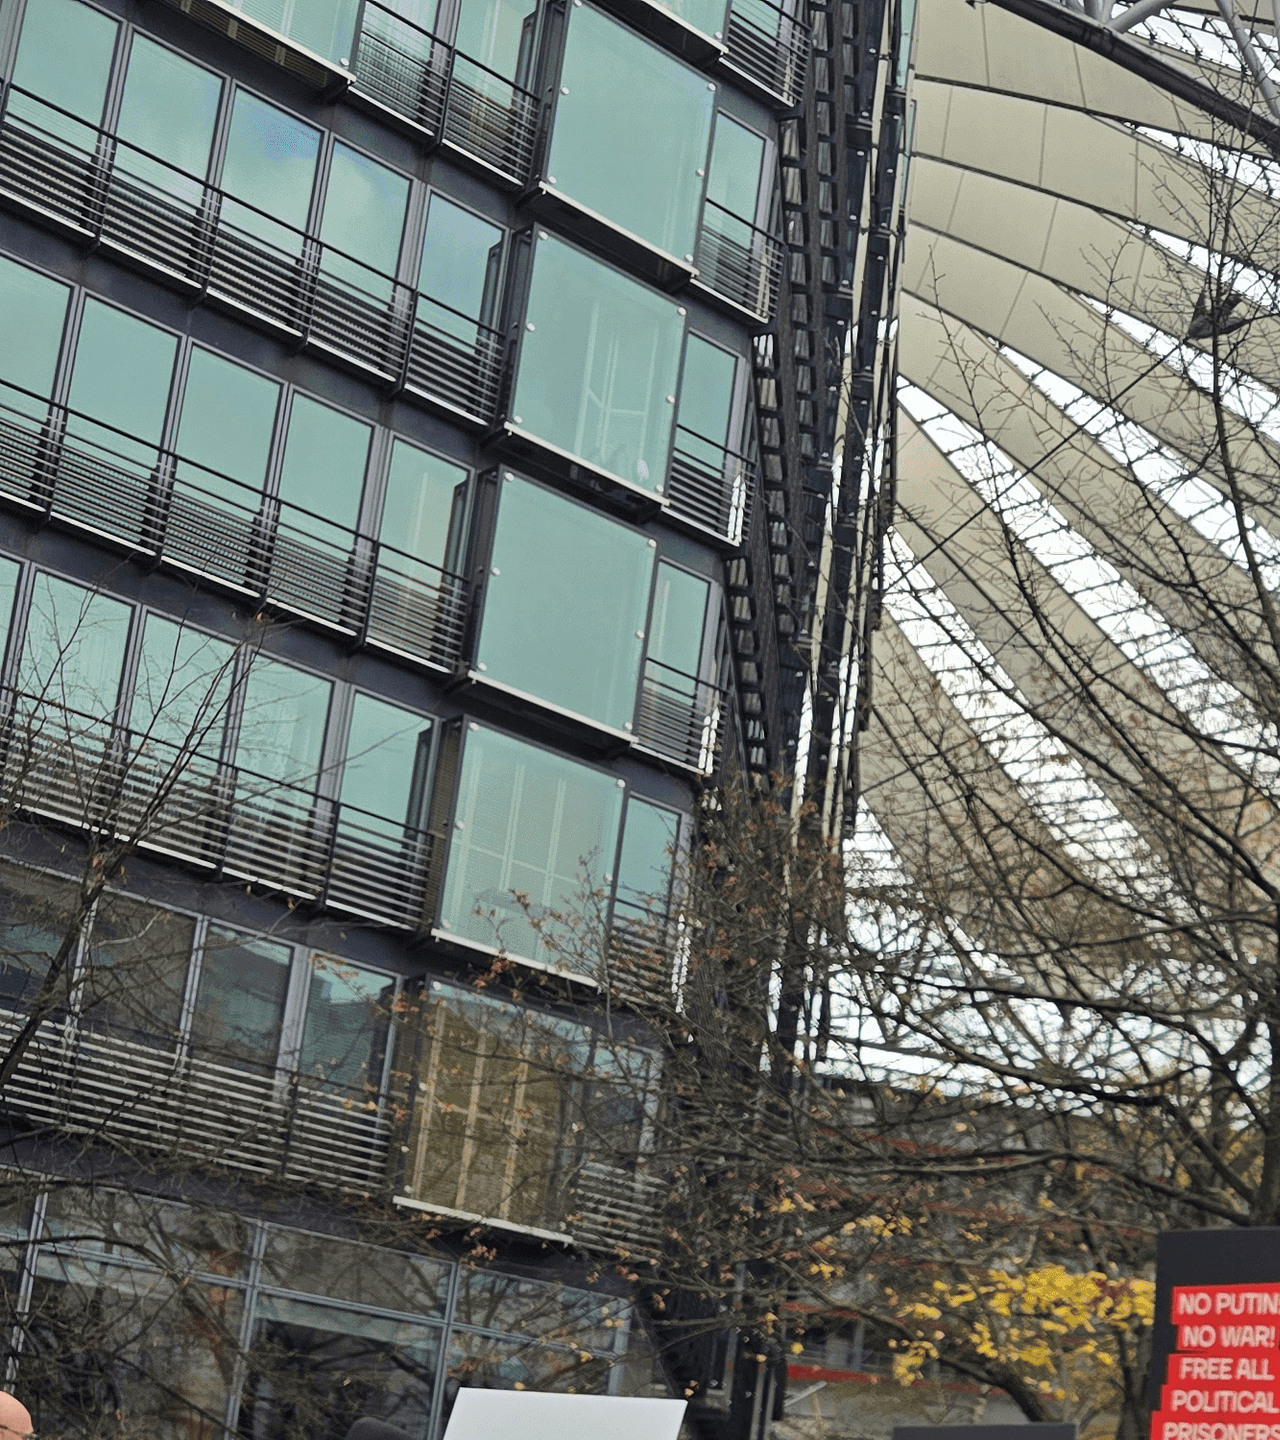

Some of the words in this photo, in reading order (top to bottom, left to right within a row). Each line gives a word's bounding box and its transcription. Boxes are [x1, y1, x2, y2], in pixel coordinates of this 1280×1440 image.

[1179, 1292, 1212, 1316] NO
[1182, 1324, 1216, 1348] NO
[1221, 1324, 1276, 1348] WAR!
[1179, 1357, 1234, 1381] FREE
[1235, 1357, 1276, 1381] ALL
[1170, 1389, 1280, 1414] POLITICAL
